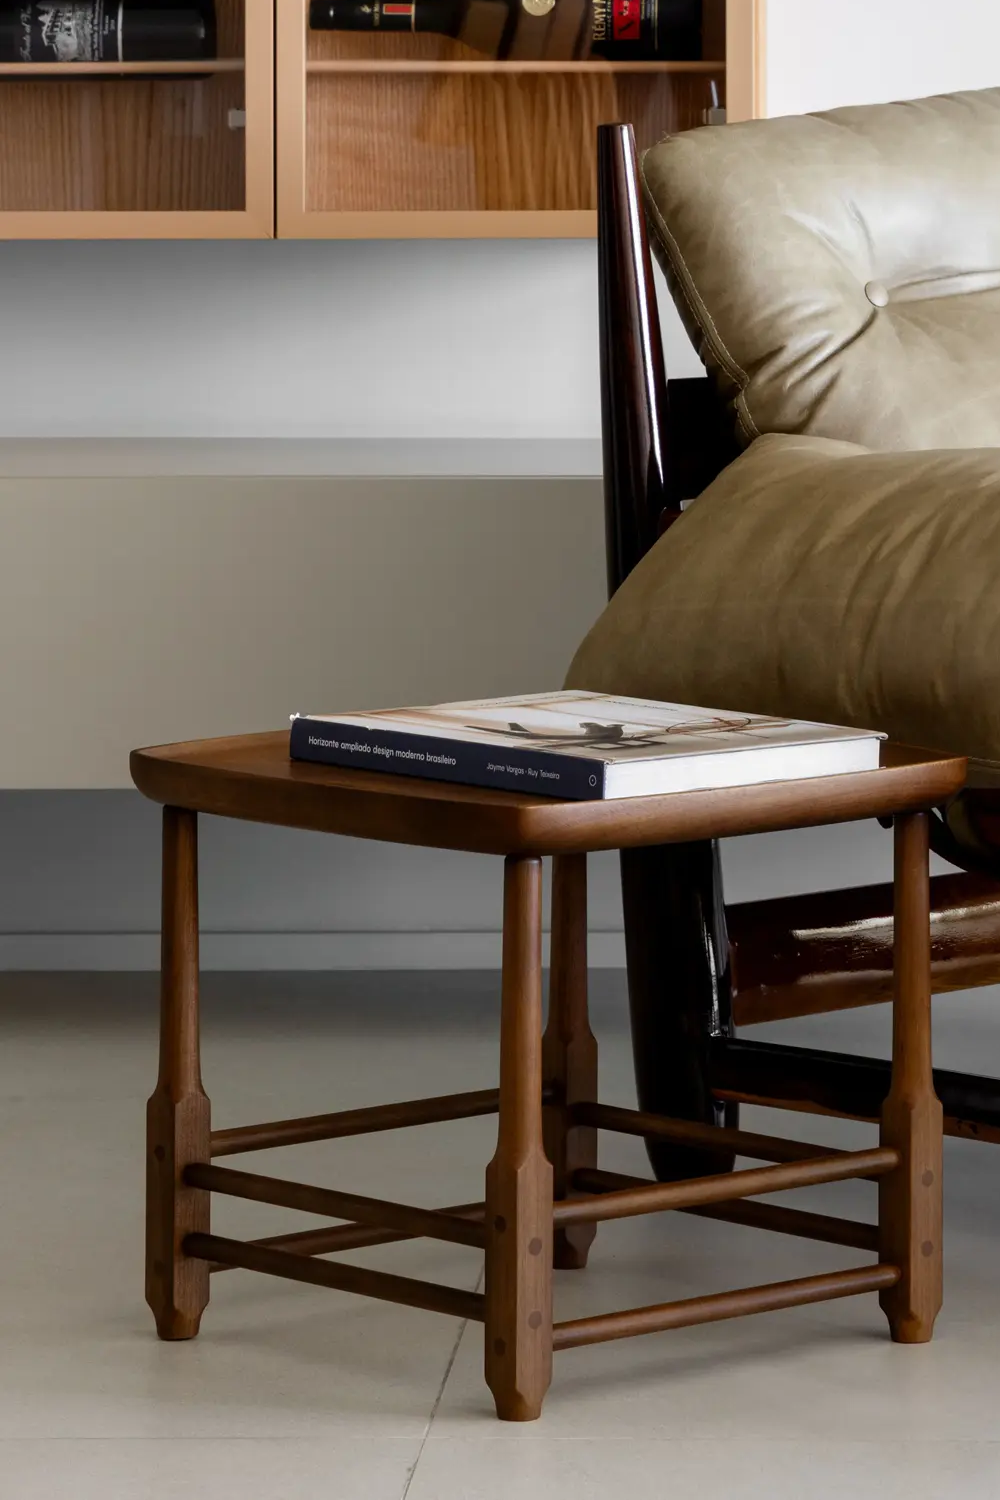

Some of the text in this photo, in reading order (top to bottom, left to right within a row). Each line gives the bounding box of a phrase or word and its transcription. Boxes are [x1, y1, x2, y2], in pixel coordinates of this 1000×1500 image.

[592, 6, 606, 41] RÉMY
[308, 736, 456, 765] Horizonte ampliado design moderno brasileiro
[486, 762, 560, 780] Jayme Vargas Ruy Teixeira
